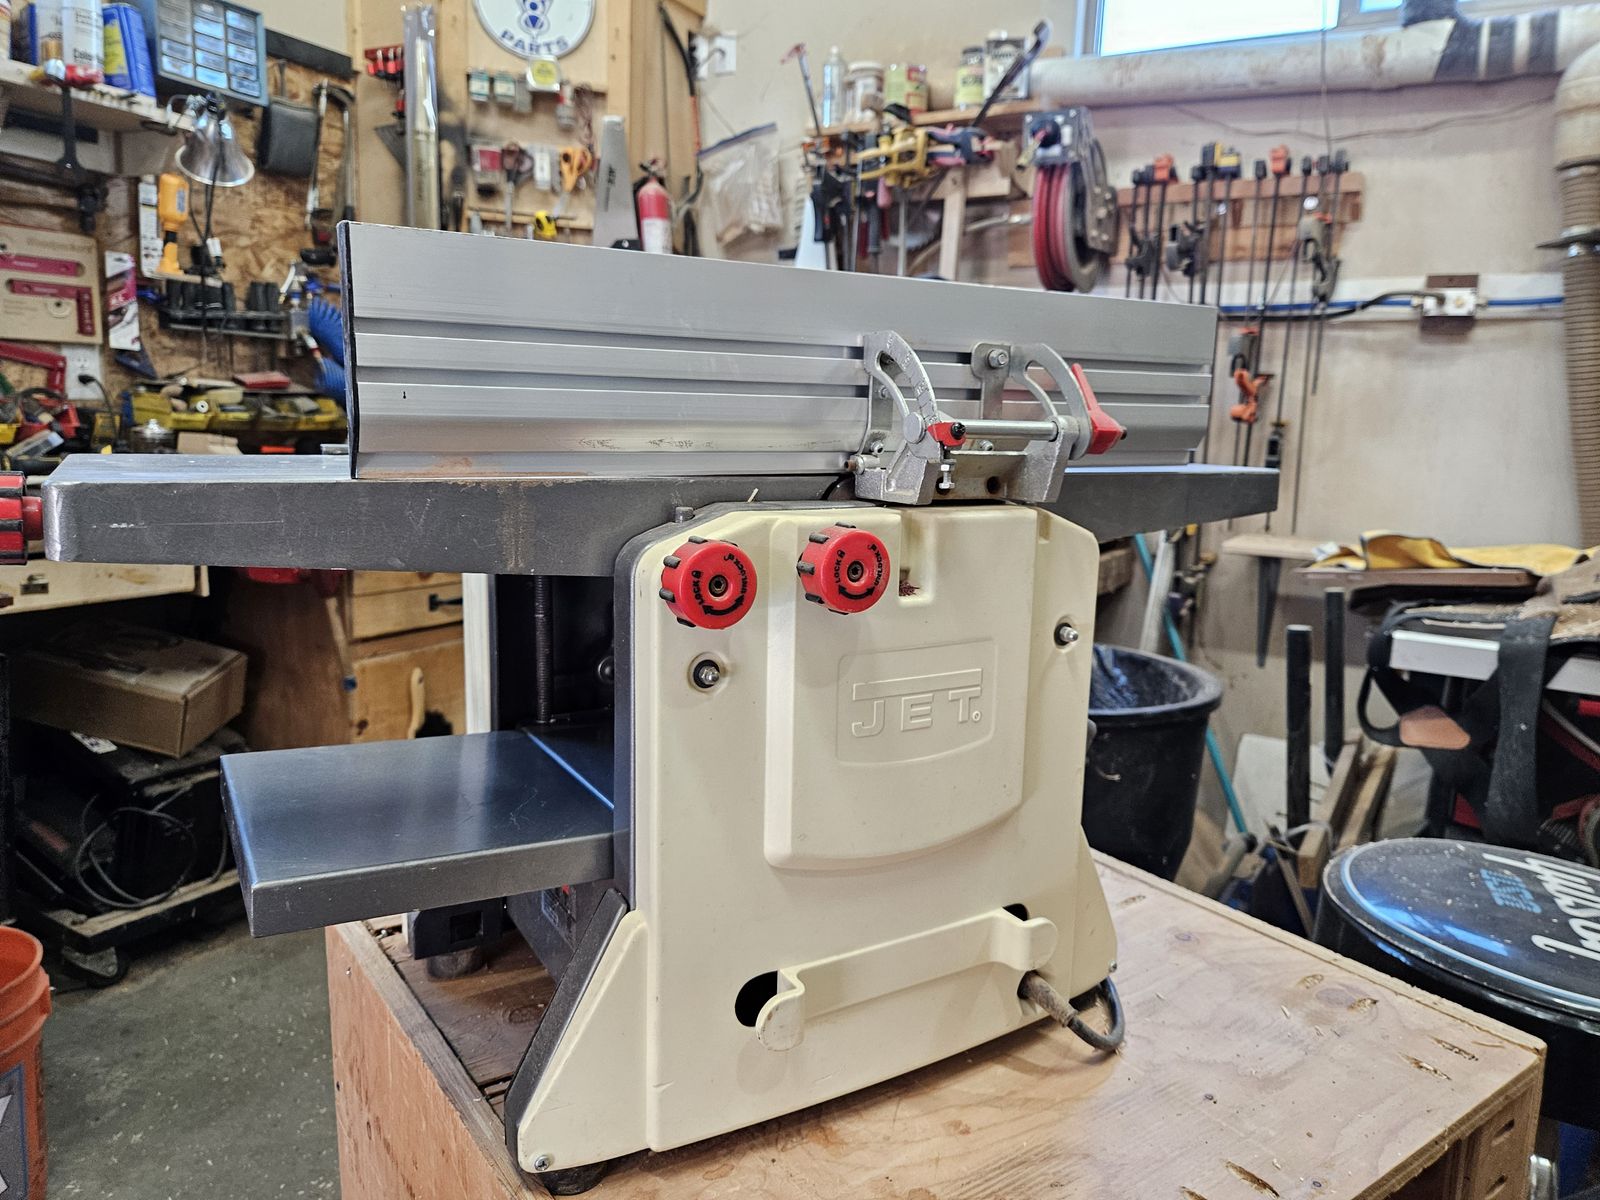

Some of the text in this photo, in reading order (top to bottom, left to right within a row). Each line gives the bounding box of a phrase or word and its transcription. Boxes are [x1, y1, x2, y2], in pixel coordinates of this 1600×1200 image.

[500, 29, 570, 54] PARTS
[733, 558, 749, 594] UNLOCK
[833, 558, 842, 584] LOCK
[873, 549, 884, 587] UNLOCK
[691, 579, 705, 606] LOCK
